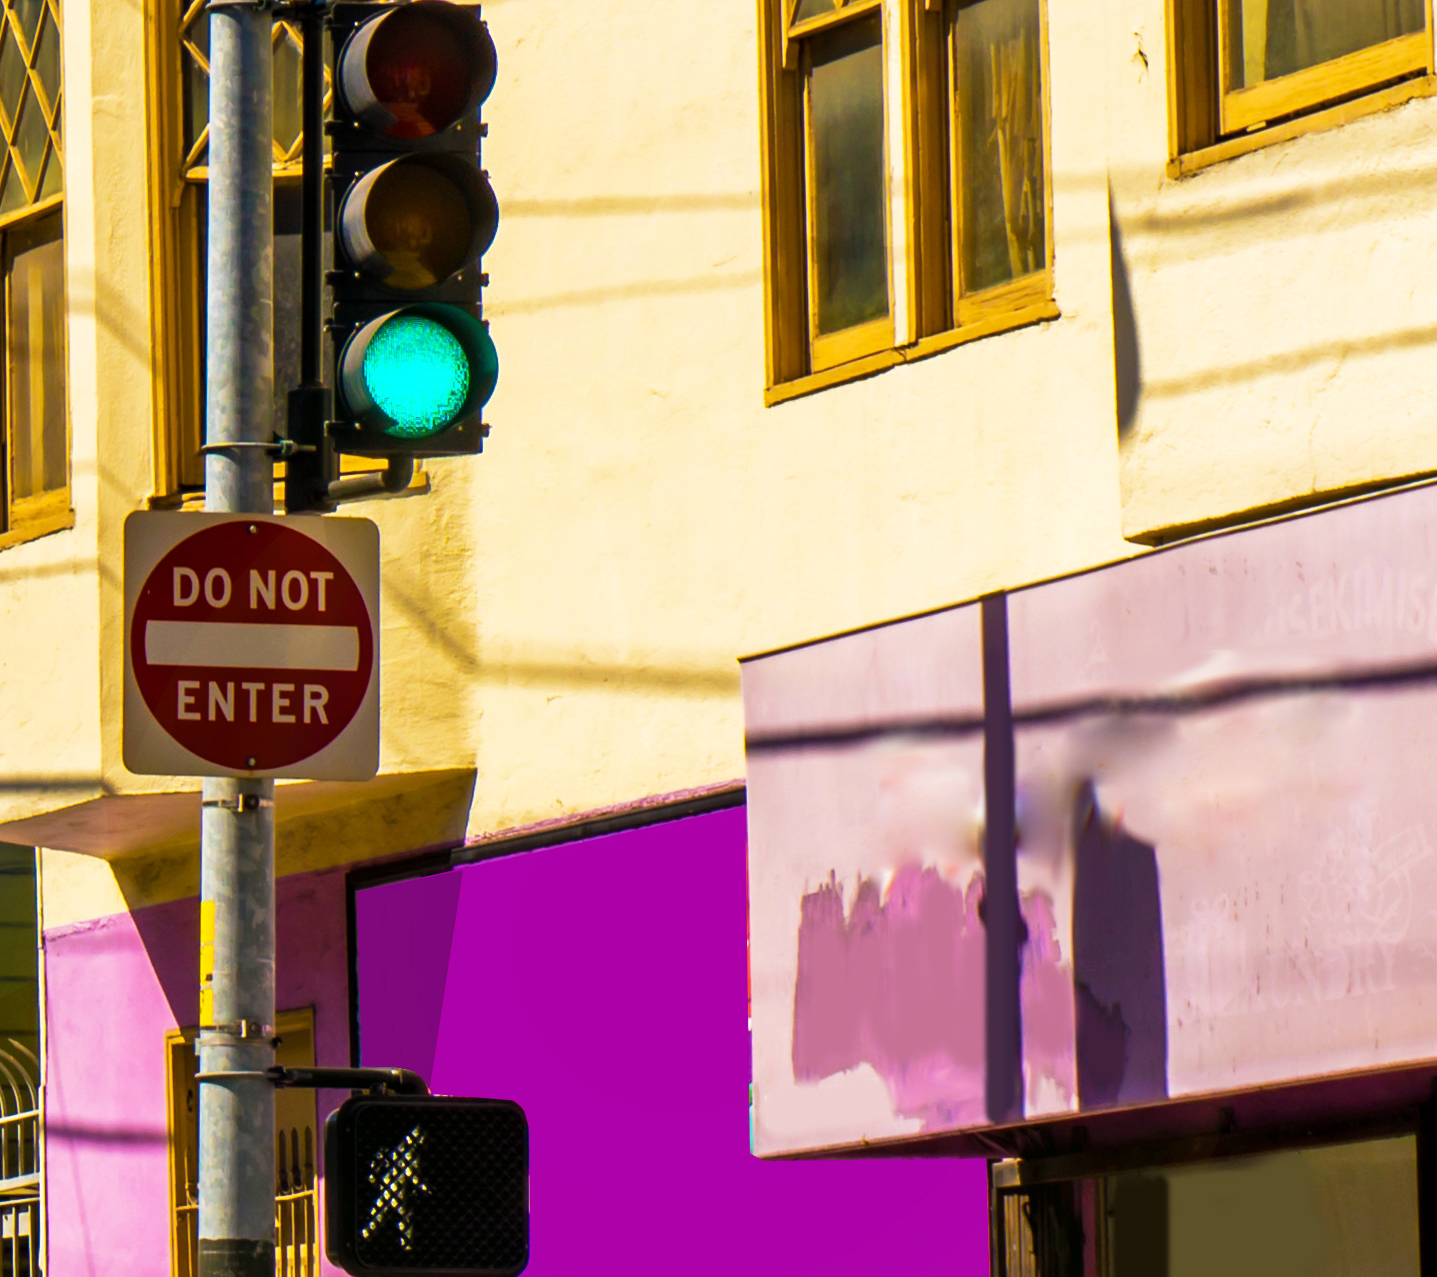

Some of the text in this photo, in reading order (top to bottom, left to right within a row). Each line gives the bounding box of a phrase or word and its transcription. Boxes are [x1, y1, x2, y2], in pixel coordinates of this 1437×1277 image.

[172, 566, 334, 612] DO NOT
[176, 680, 330, 725] ENTER
